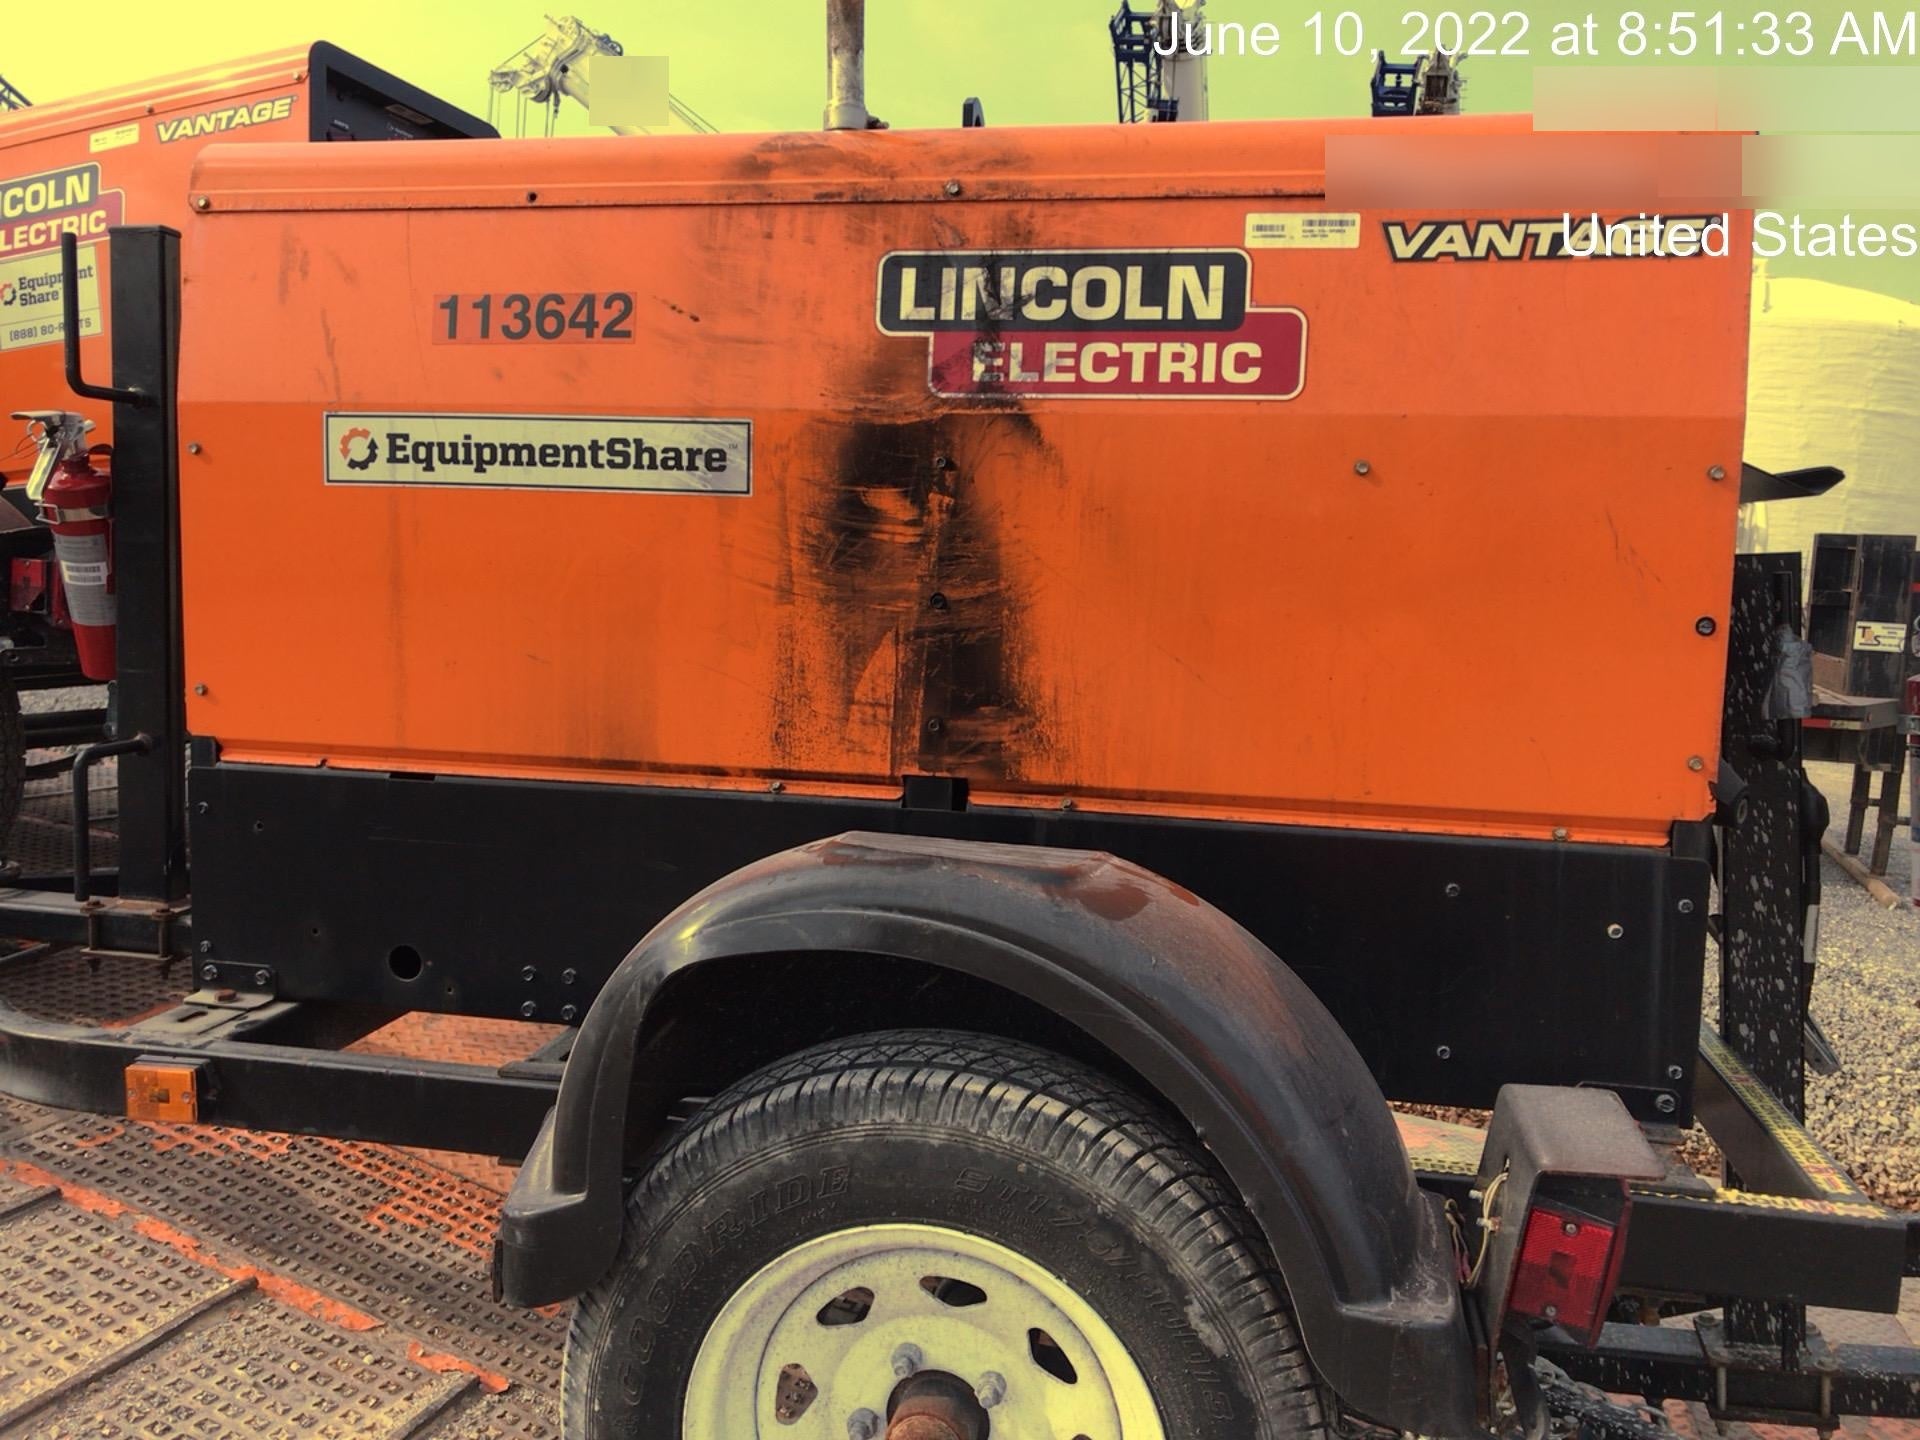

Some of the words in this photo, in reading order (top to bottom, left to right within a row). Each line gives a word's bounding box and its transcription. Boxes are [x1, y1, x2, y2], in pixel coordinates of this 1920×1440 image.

[156, 97, 292, 143] VANTAGE
[0, 172, 90, 218] COLN
[1386, 217, 1710, 260] VANTAGE
[18, 265, 93, 291] Equipnt
[19, 288, 60, 307] Share
[899, 264, 1226, 321] LINCOLN
[41, 317, 92, 337] 80-RTS
[439, 293, 634, 340] 113642
[972, 341, 1262, 384] ELECTRIC
[386, 432, 728, 474] EquipmentShare
